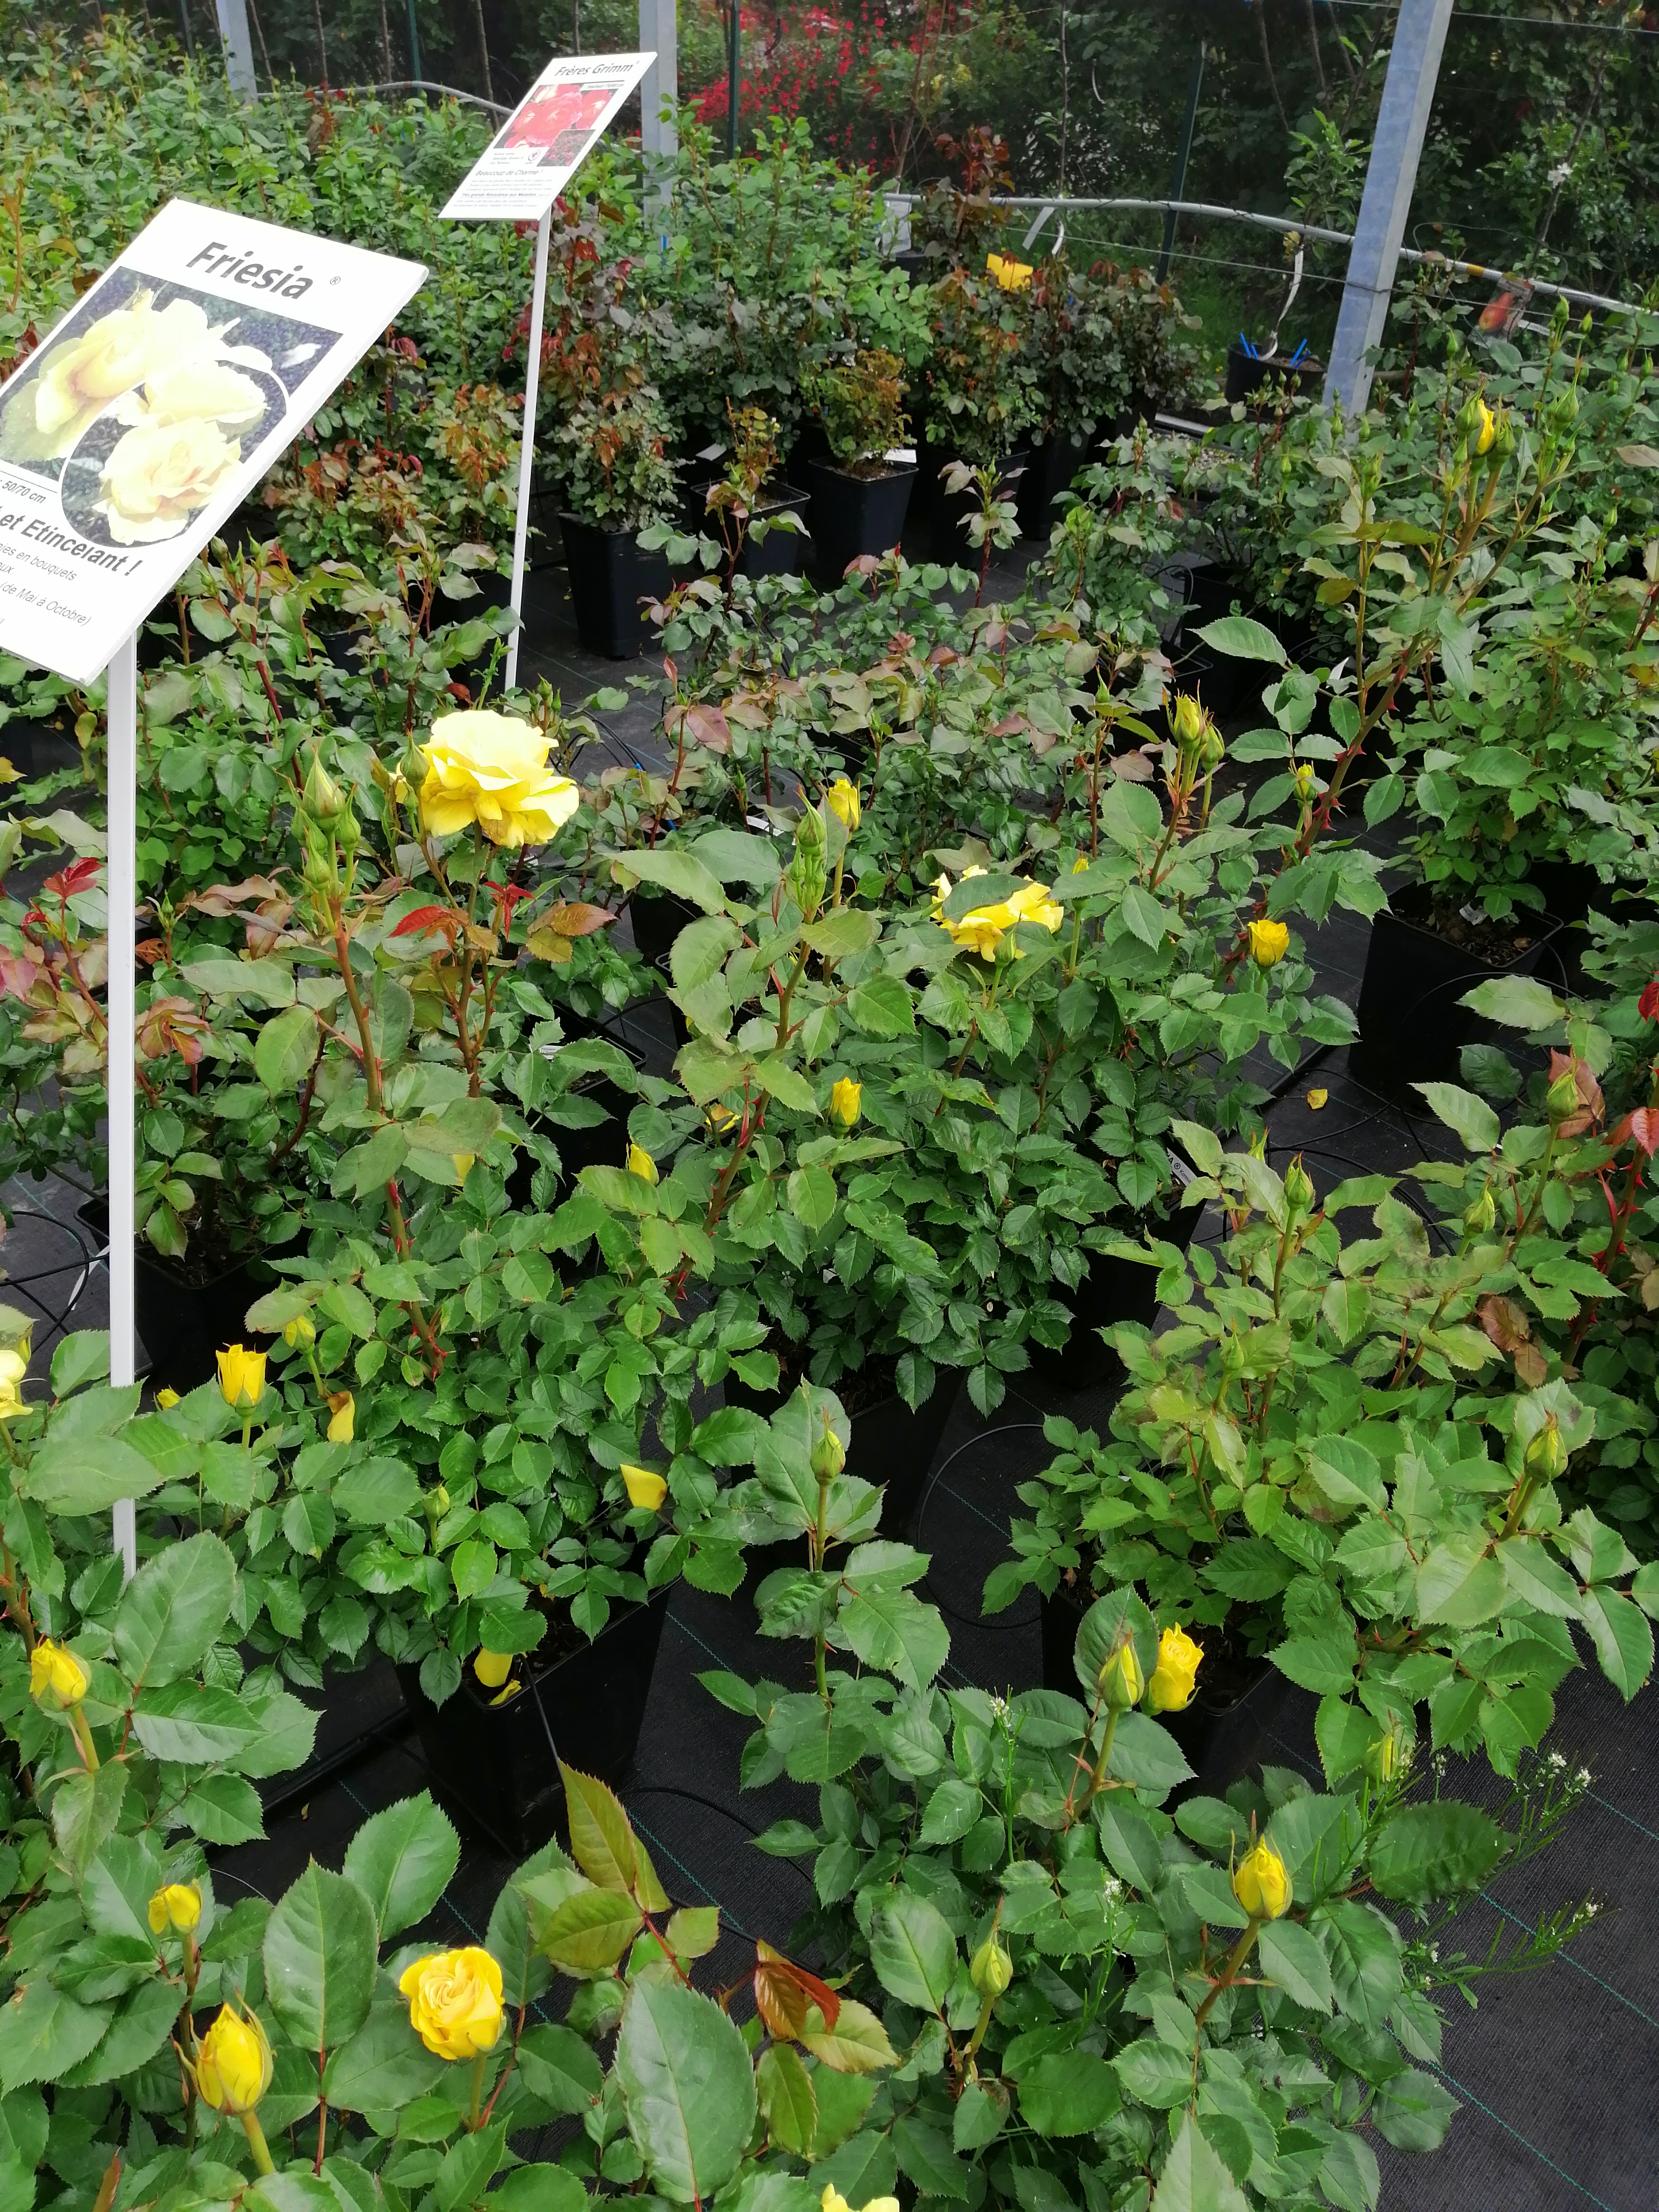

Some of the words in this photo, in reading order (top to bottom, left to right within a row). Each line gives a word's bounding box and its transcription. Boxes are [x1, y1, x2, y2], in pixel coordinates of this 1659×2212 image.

[554, 65, 591, 76] Frères
[592, 63, 633, 74] Grimm
[185, 241, 313, 300] Friesia
[2, 481, 31, 496] 50/70
[29, 493, 46, 504] cm
[0, 514, 26, 530] et
[20, 519, 130, 572] Etincelant
[124, 560, 144, 576] !
[16, 552, 31, 562] en
[30, 555, 77, 580] bouquets
[16, 589, 40, 603] Mai
[36, 597, 47, 606] à
[46, 601, 92, 627] Octobre)
